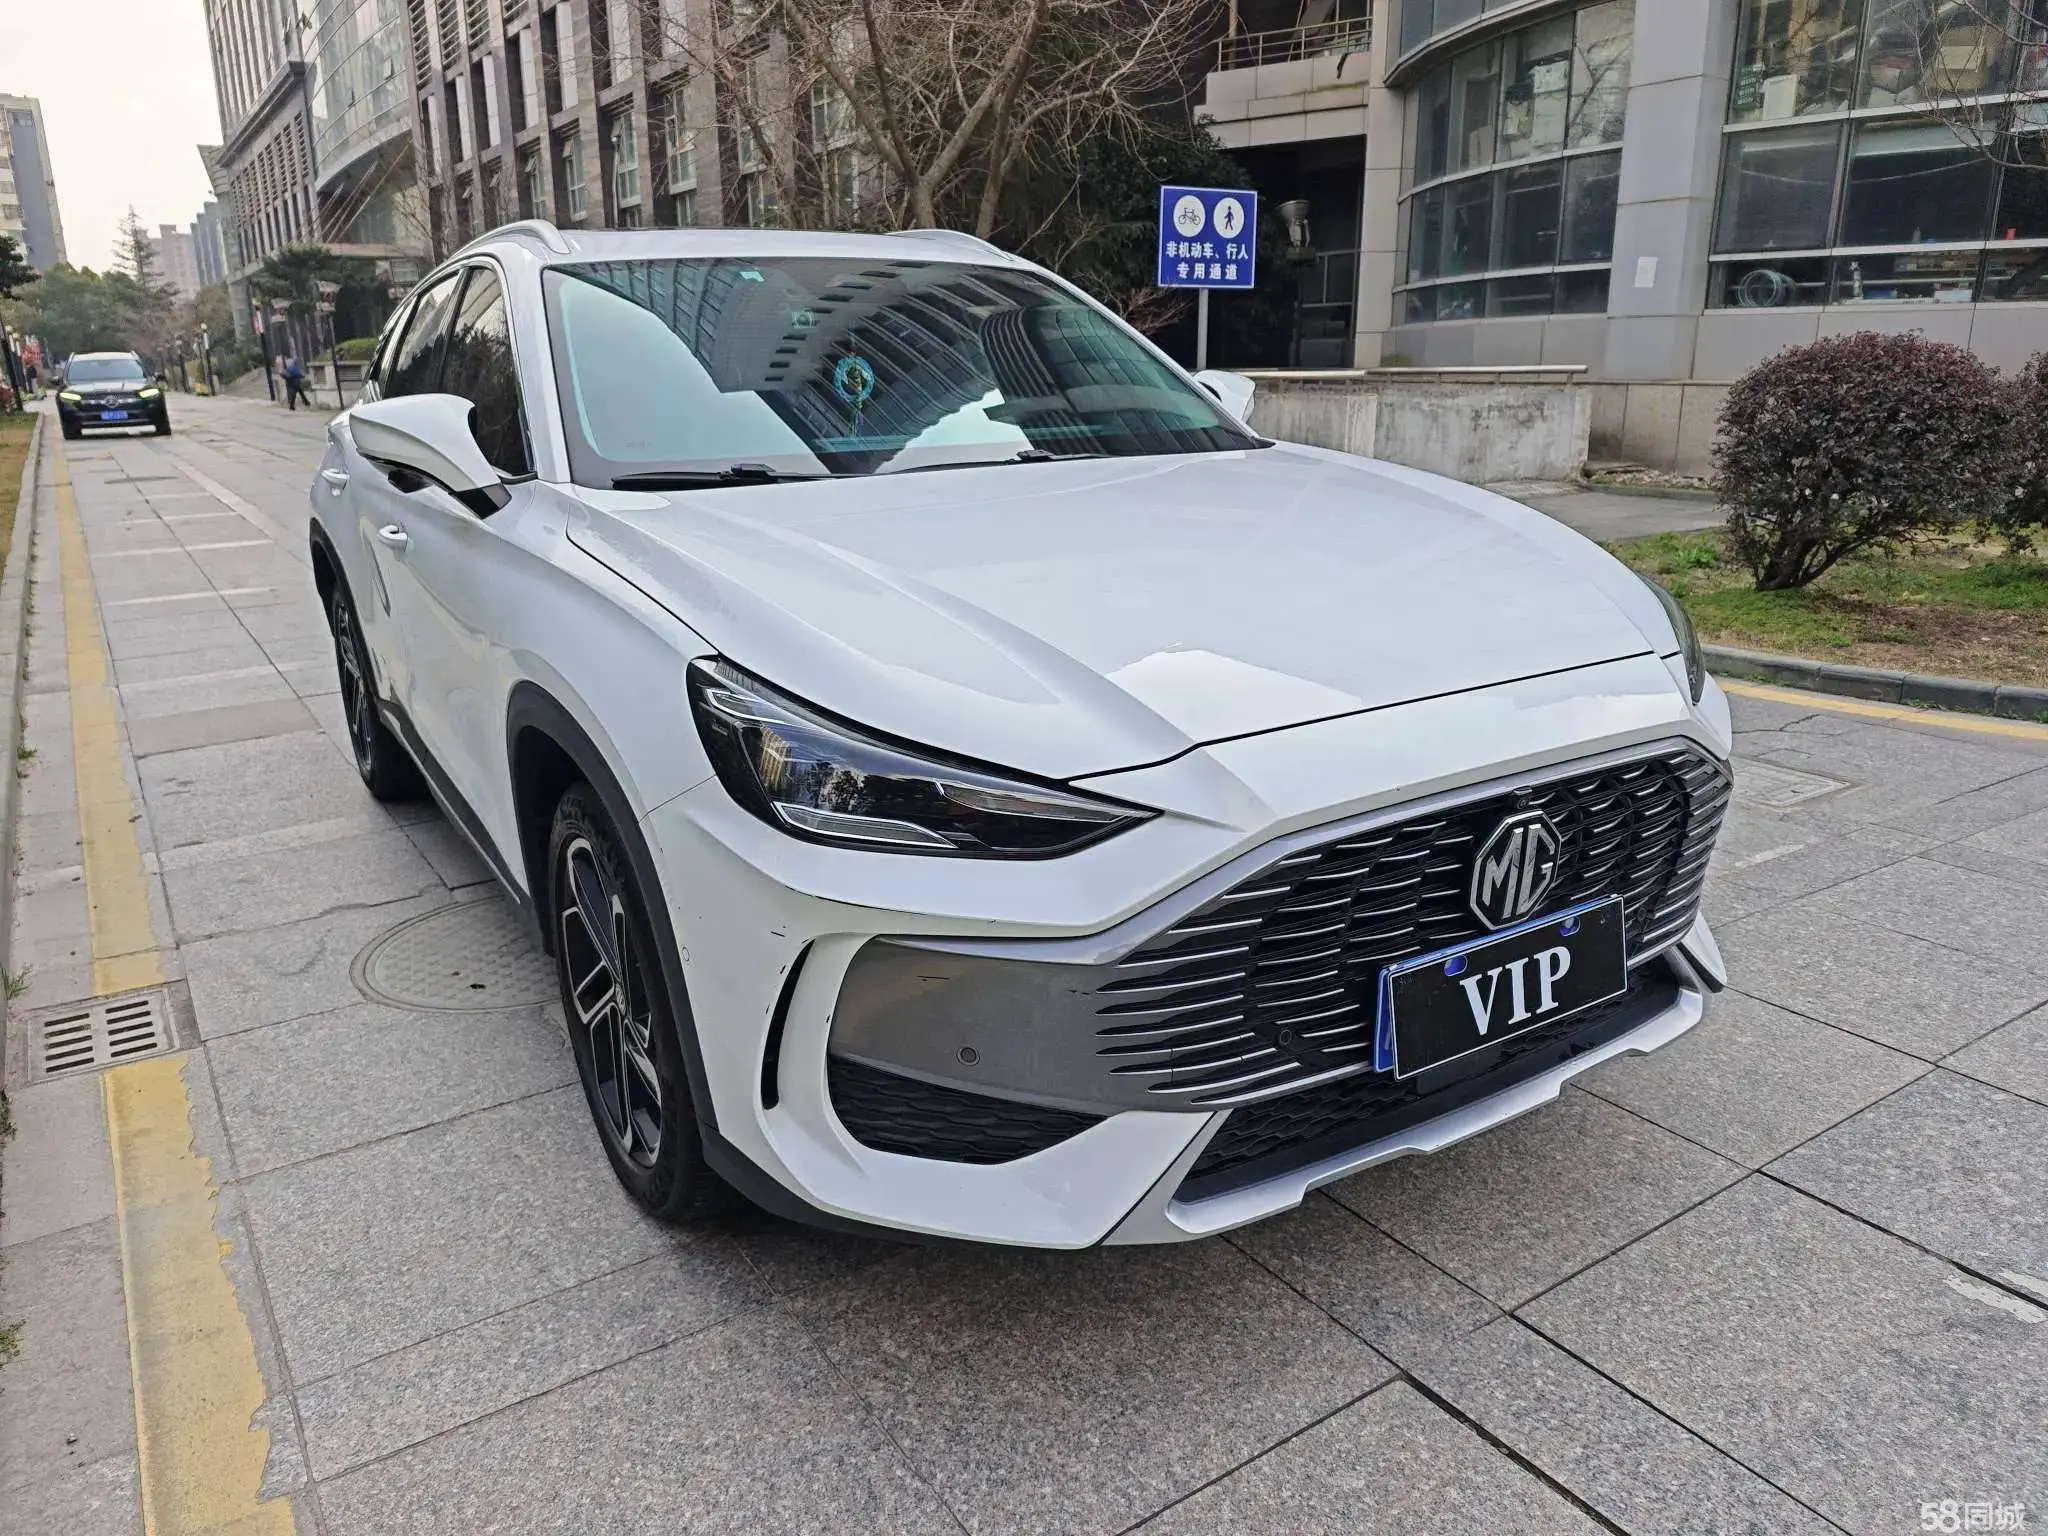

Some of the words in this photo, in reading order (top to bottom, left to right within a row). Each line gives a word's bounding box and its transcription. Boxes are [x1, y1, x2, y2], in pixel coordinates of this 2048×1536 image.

[1166, 241, 1248, 260] 非机动车、行人
[1176, 261, 1238, 280] 专用通道
[1482, 823, 1555, 919] MG
[1459, 945, 1571, 1036] VIP
